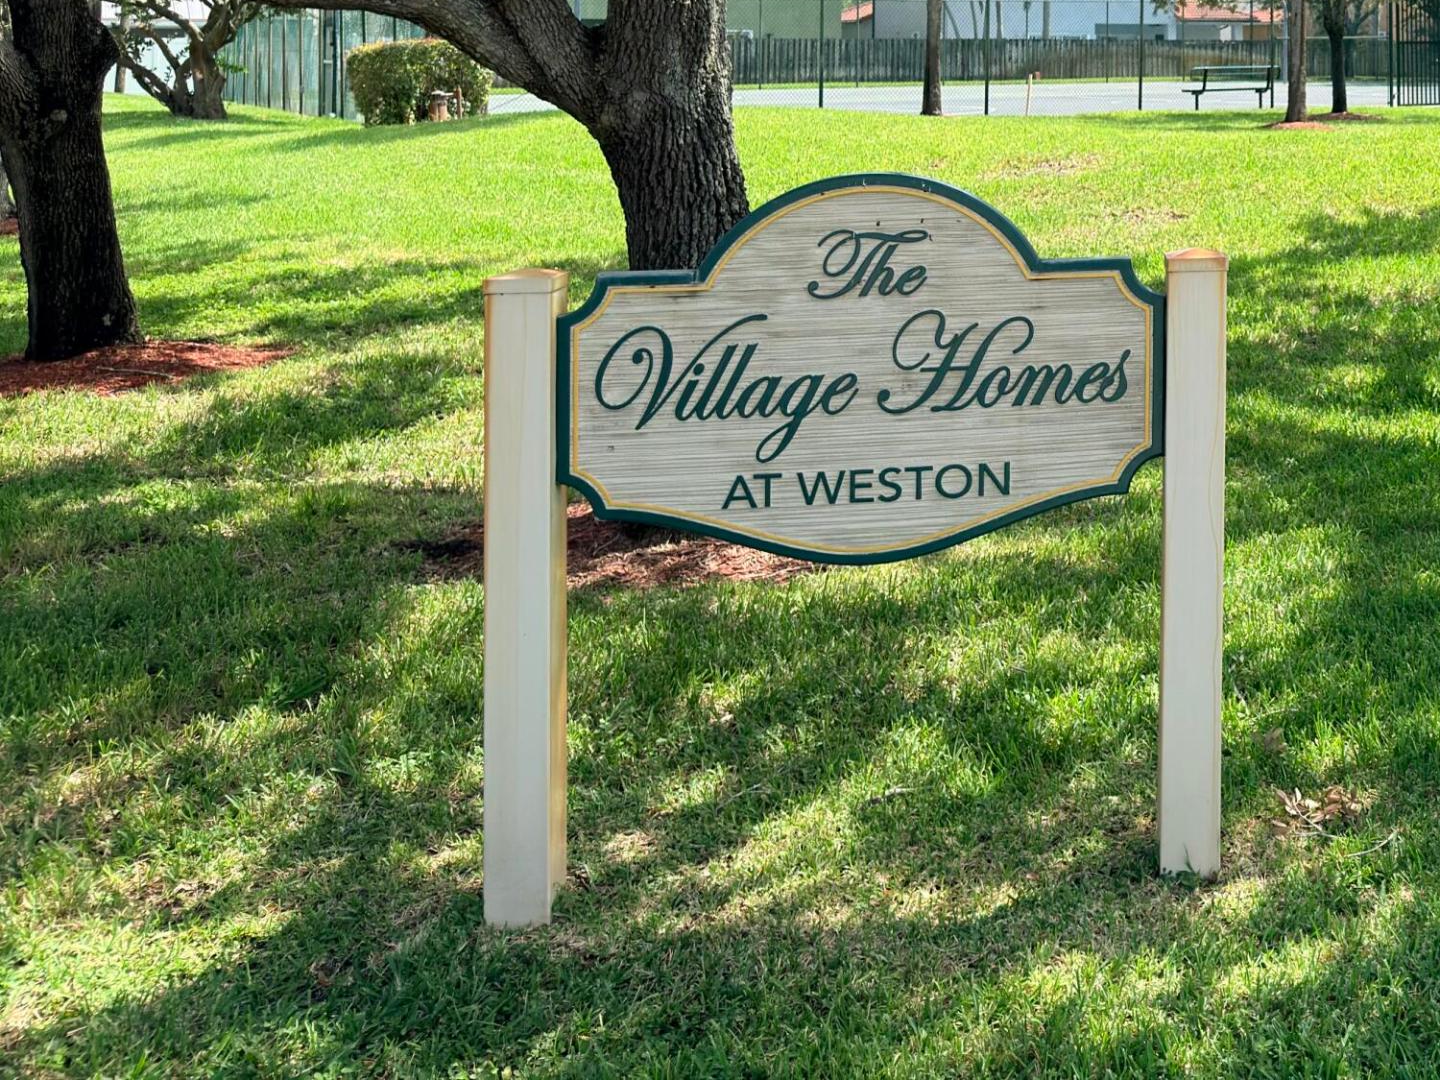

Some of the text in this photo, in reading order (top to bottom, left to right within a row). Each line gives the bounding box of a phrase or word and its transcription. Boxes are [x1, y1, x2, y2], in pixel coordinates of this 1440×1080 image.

[806, 228, 928, 300] The
[594, 308, 1132, 464] Village Homes
[721, 460, 1012, 510] AT WESTON
